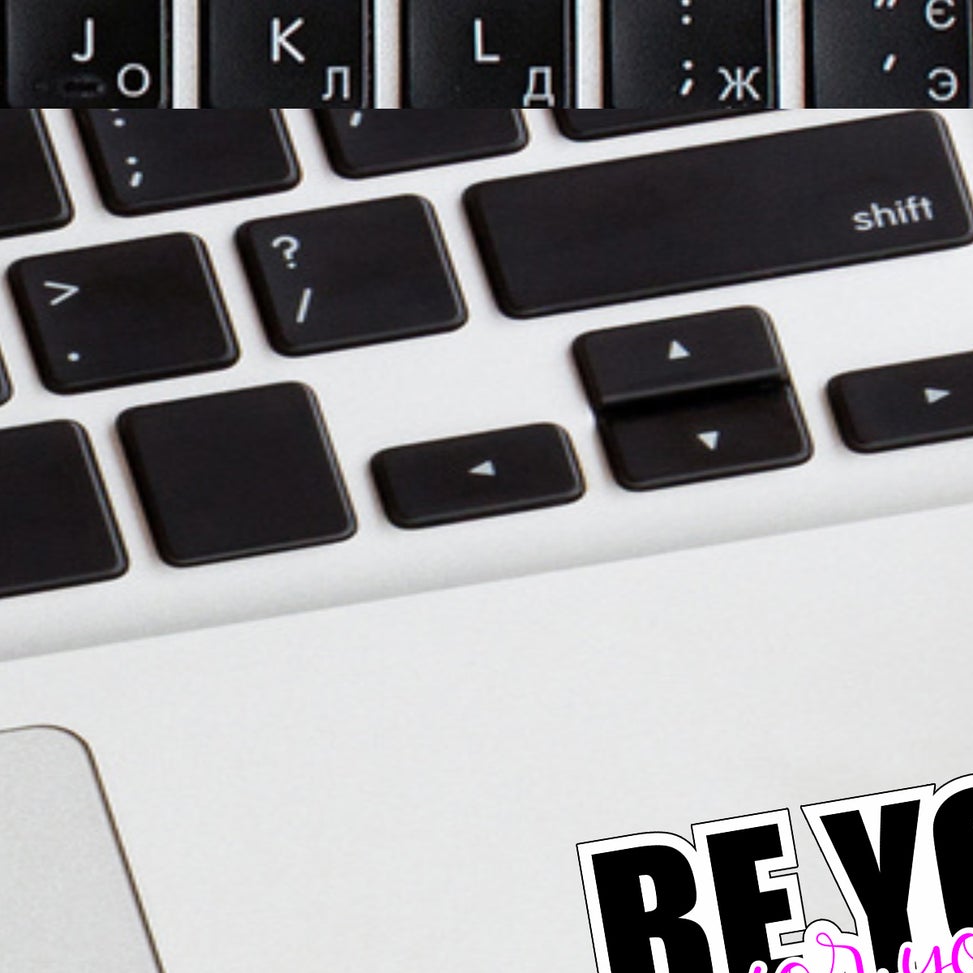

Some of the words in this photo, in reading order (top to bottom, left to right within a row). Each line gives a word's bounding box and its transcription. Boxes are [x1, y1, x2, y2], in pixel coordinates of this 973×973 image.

[72, 18, 94, 62] J
[272, 17, 305, 62] K
[474, 19, 500, 62] L
[322, 66, 350, 101] Л
[523, 66, 555, 107] Д
[680, 60, 693, 96] ;
[718, 66, 760, 101] Ж
[928, 67, 958, 101] Э
[853, 195, 933, 231] shift
[271, 235, 299, 269] ?
[44, 281, 79, 306] >
[296, 287, 312, 323] /
